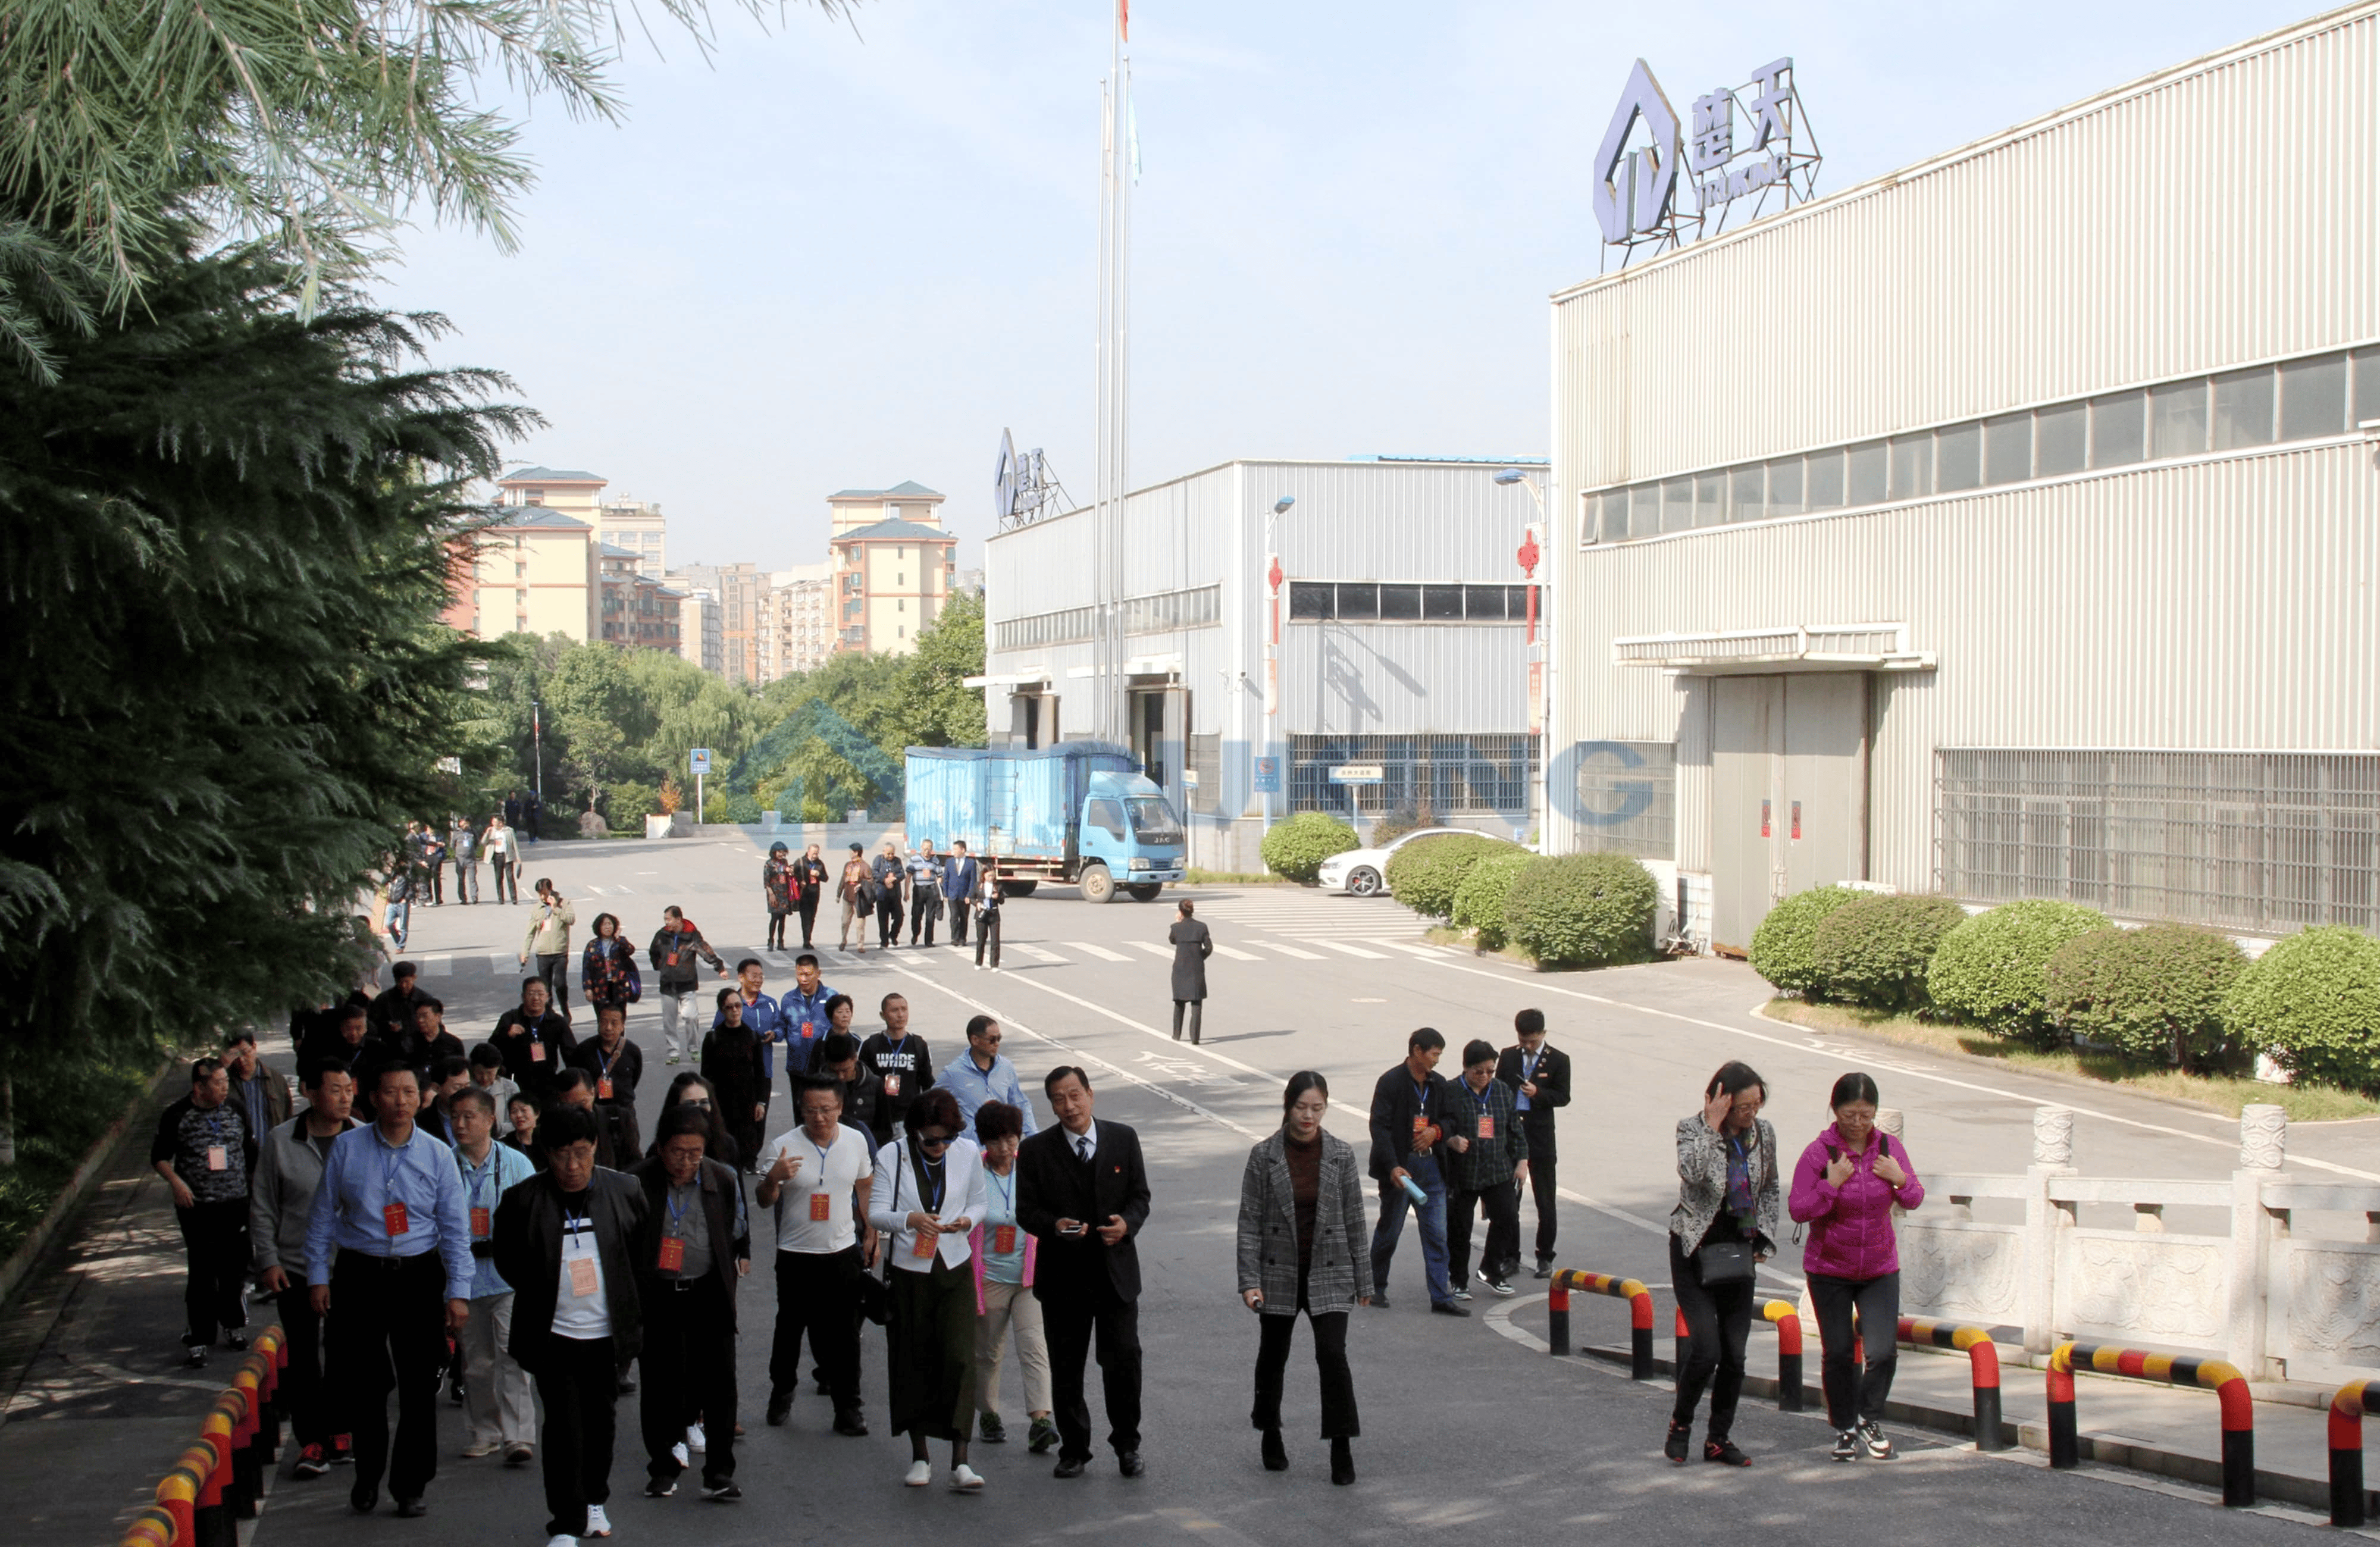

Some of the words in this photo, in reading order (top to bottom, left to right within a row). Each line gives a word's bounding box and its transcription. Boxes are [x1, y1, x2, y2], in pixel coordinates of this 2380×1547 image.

[1692, 57, 1793, 176] 楚天
[1693, 152, 1792, 212] TRUKING
[876, 1053, 915, 1071] WADE
[1132, 1050, 1250, 1087] 人行道
